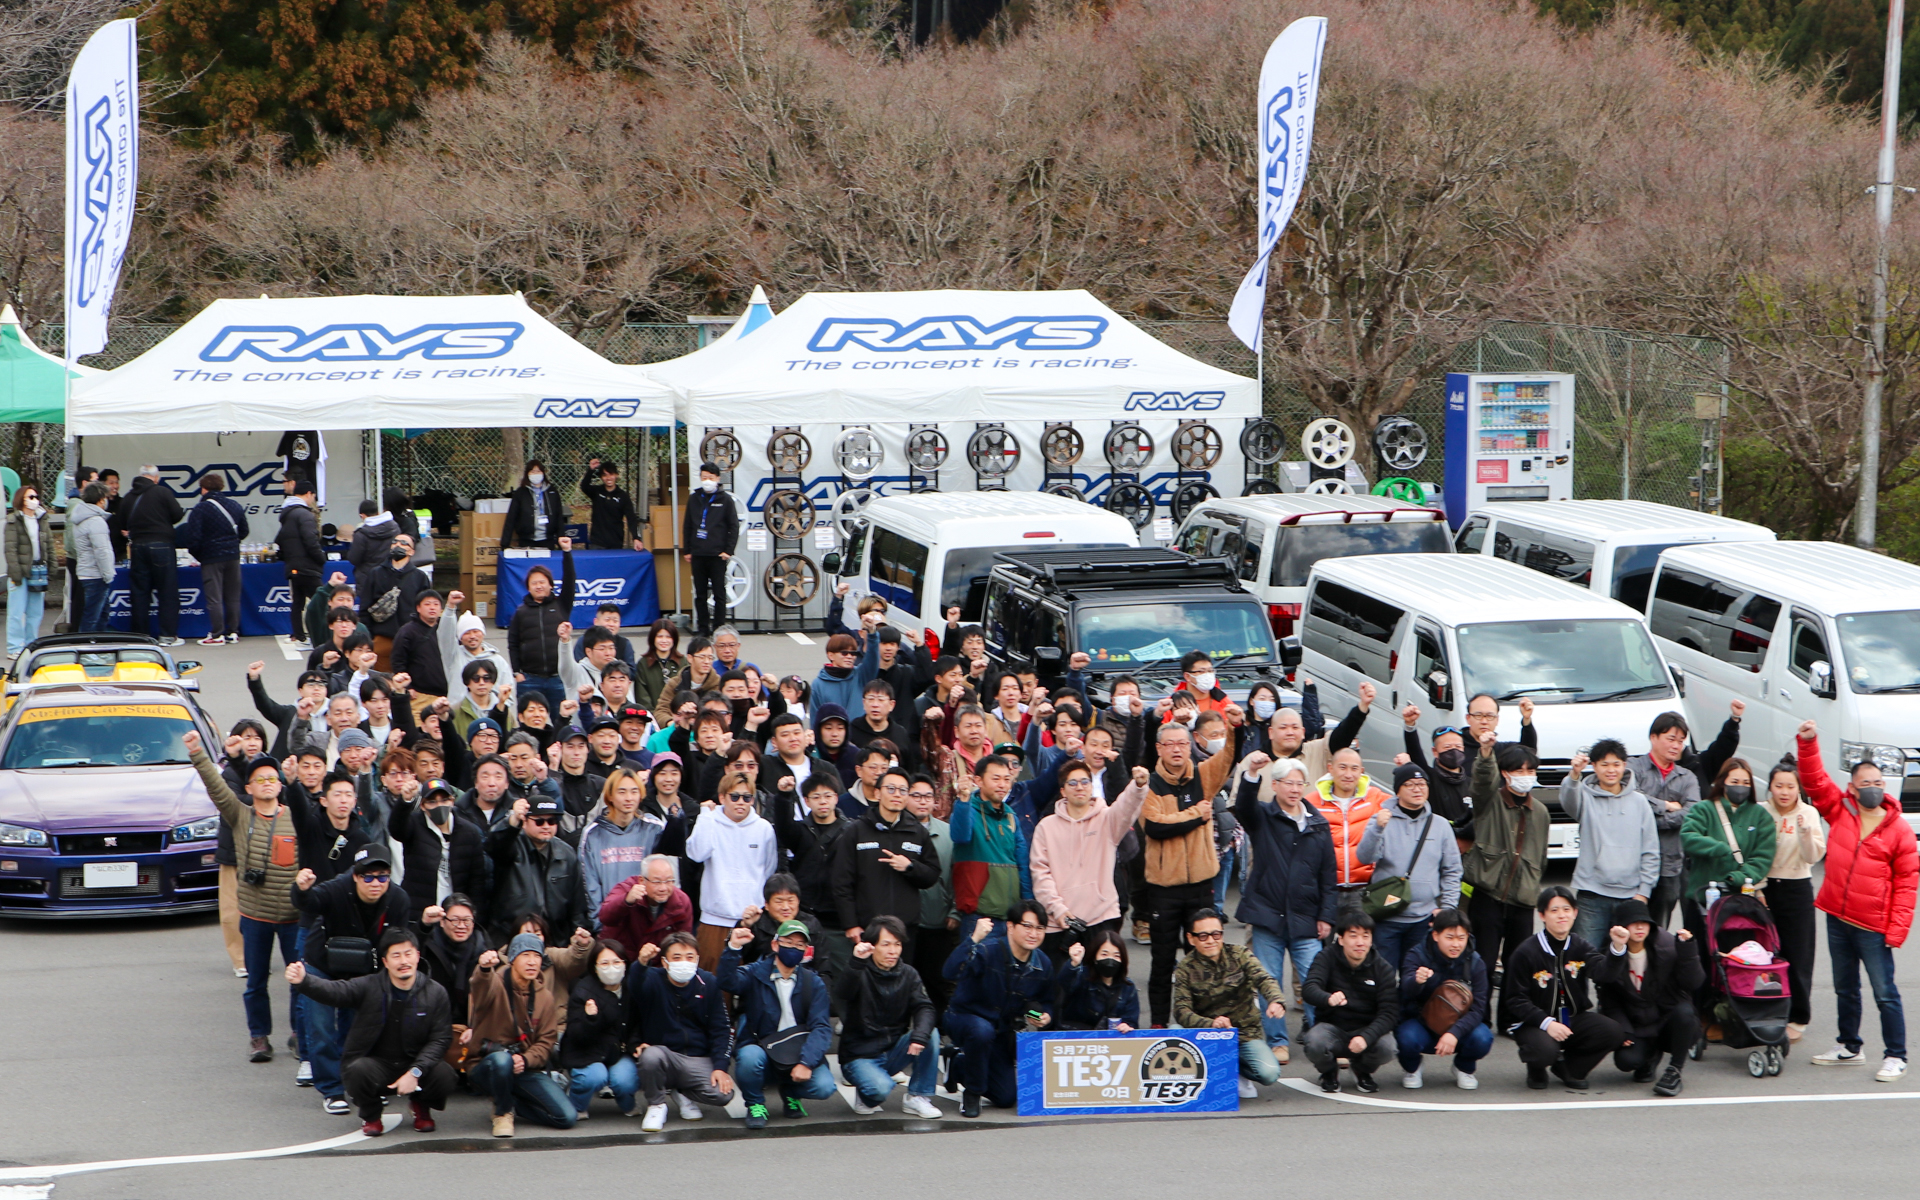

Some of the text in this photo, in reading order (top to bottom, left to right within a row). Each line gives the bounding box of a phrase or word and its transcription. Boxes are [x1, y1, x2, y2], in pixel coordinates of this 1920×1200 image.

[199, 321, 525, 363] RAYS
[806, 315, 1110, 353] RAYS
[784, 355, 1138, 372] The concept is racing.
[172, 364, 547, 383] The concept is racing.
[533, 398, 641, 418] RAYS
[1123, 390, 1226, 412] RAYS
[92, 706, 121, 714] Car
[125, 705, 175, 715] Studio
[1195, 1031, 1235, 1041] RAYS
[1053, 1045, 1110, 1055] 3月7日は
[1052, 1055, 1132, 1087] TE37
[1101, 1087, 1130, 1099] の日
[1142, 1082, 1203, 1099] TE37
